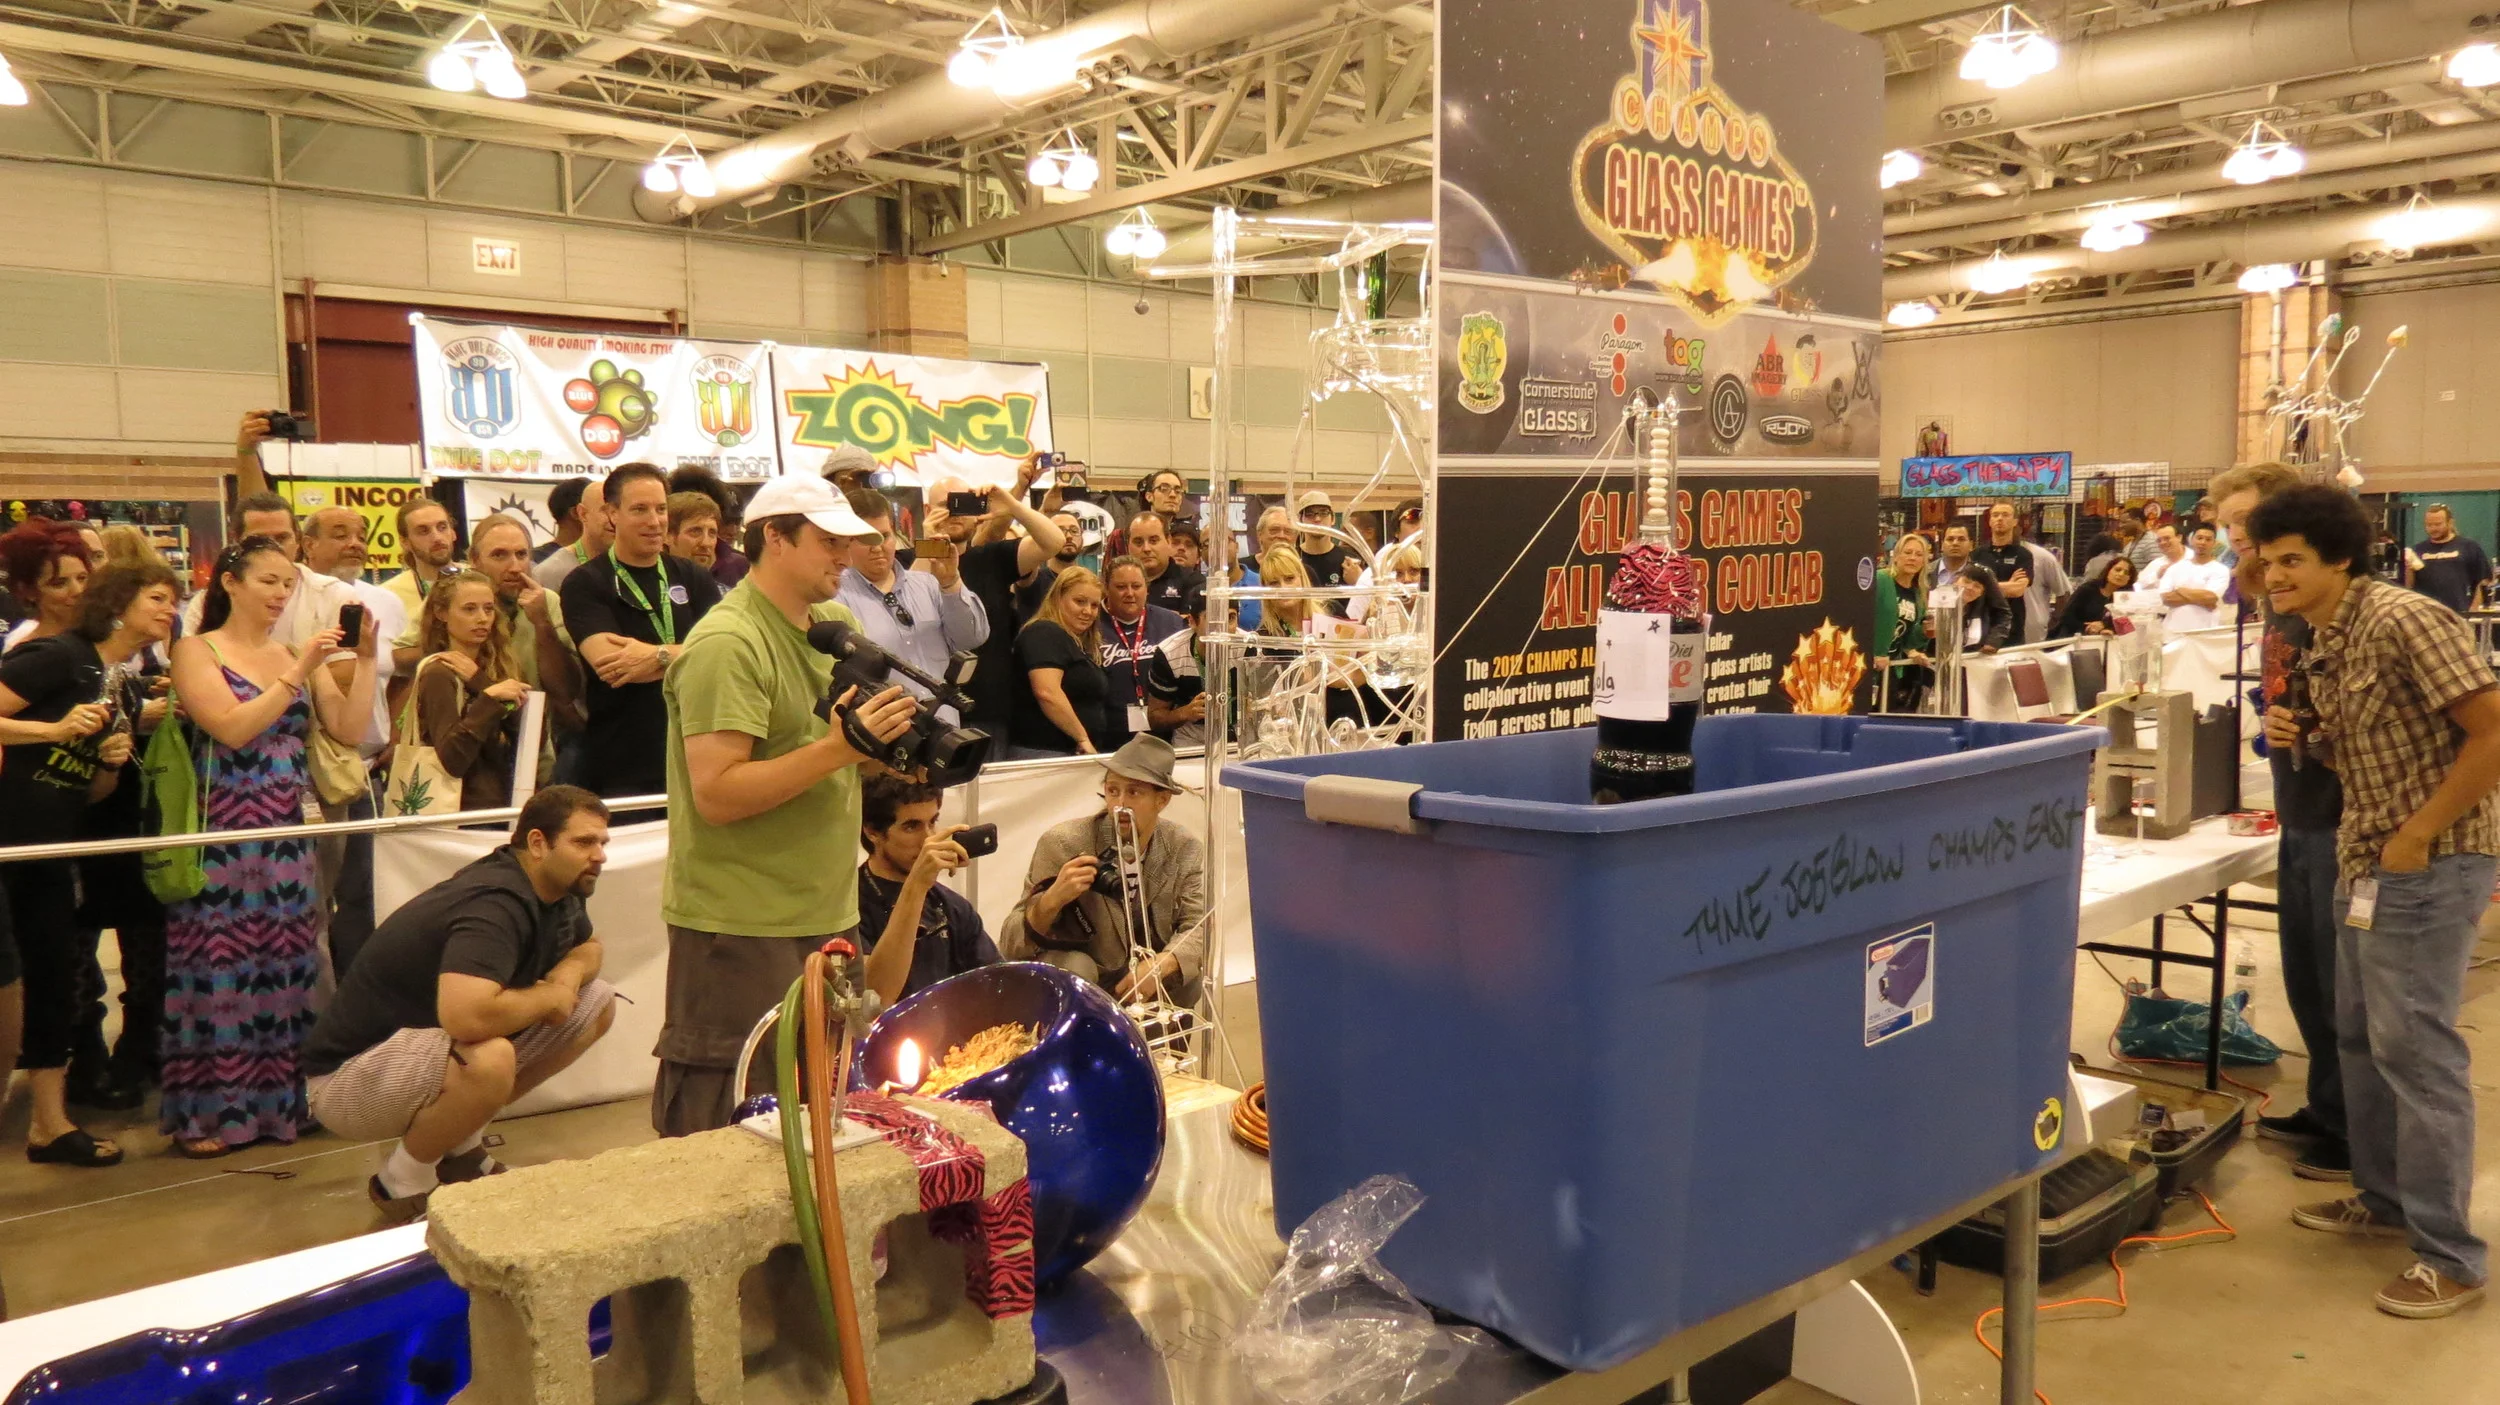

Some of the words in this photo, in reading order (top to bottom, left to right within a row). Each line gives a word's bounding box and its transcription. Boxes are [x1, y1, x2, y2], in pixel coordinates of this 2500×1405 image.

[1619, 84, 1768, 164] CHAMPS
[1605, 143, 1702, 241] GLASS
[1706, 165, 1795, 262] GAMES
[476, 244, 516, 269] EXIT
[529, 335, 554, 349] HIGH
[1601, 333, 1644, 353] Paragon
[1664, 328, 1706, 395] tag
[1756, 354, 1784, 373] ABR
[569, 391, 593, 401] BLUE
[788, 378, 1035, 457] ZONG!
[584, 429, 620, 443] DOT
[490, 450, 542, 473] DOT
[552, 463, 595, 474] MADE
[727, 457, 773, 478] DOT
[1906, 462, 1961, 488] GLASS
[1963, 455, 2064, 489] THERAPY
[334, 487, 424, 508] INCOG
[1579, 490, 1693, 556] GLAS
[1700, 488, 1803, 551] GAMES
[1716, 551, 1823, 614] COLLAB
[1100, 640, 1161, 668] Yankee
[1465, 658, 1489, 681] The
[1492, 654, 1524, 678] 2012
[1526, 648, 1577, 674] CHAMPS
[1705, 632, 1734, 652] tellar
[1463, 682, 1552, 712] collaborative
[1554, 675, 1590, 699] event
[1711, 657, 1738, 680] glass
[1738, 652, 1773, 674] artists
[1593, 661, 1616, 692] ola
[1463, 718, 1498, 741] from
[1500, 712, 1546, 736] across
[1549, 706, 1570, 729] the
[1707, 681, 1746, 704] creates
[1748, 676, 1771, 697] their
[1928, 815, 2016, 872] CHAMPS
[2023, 797, 2084, 853] EAST
